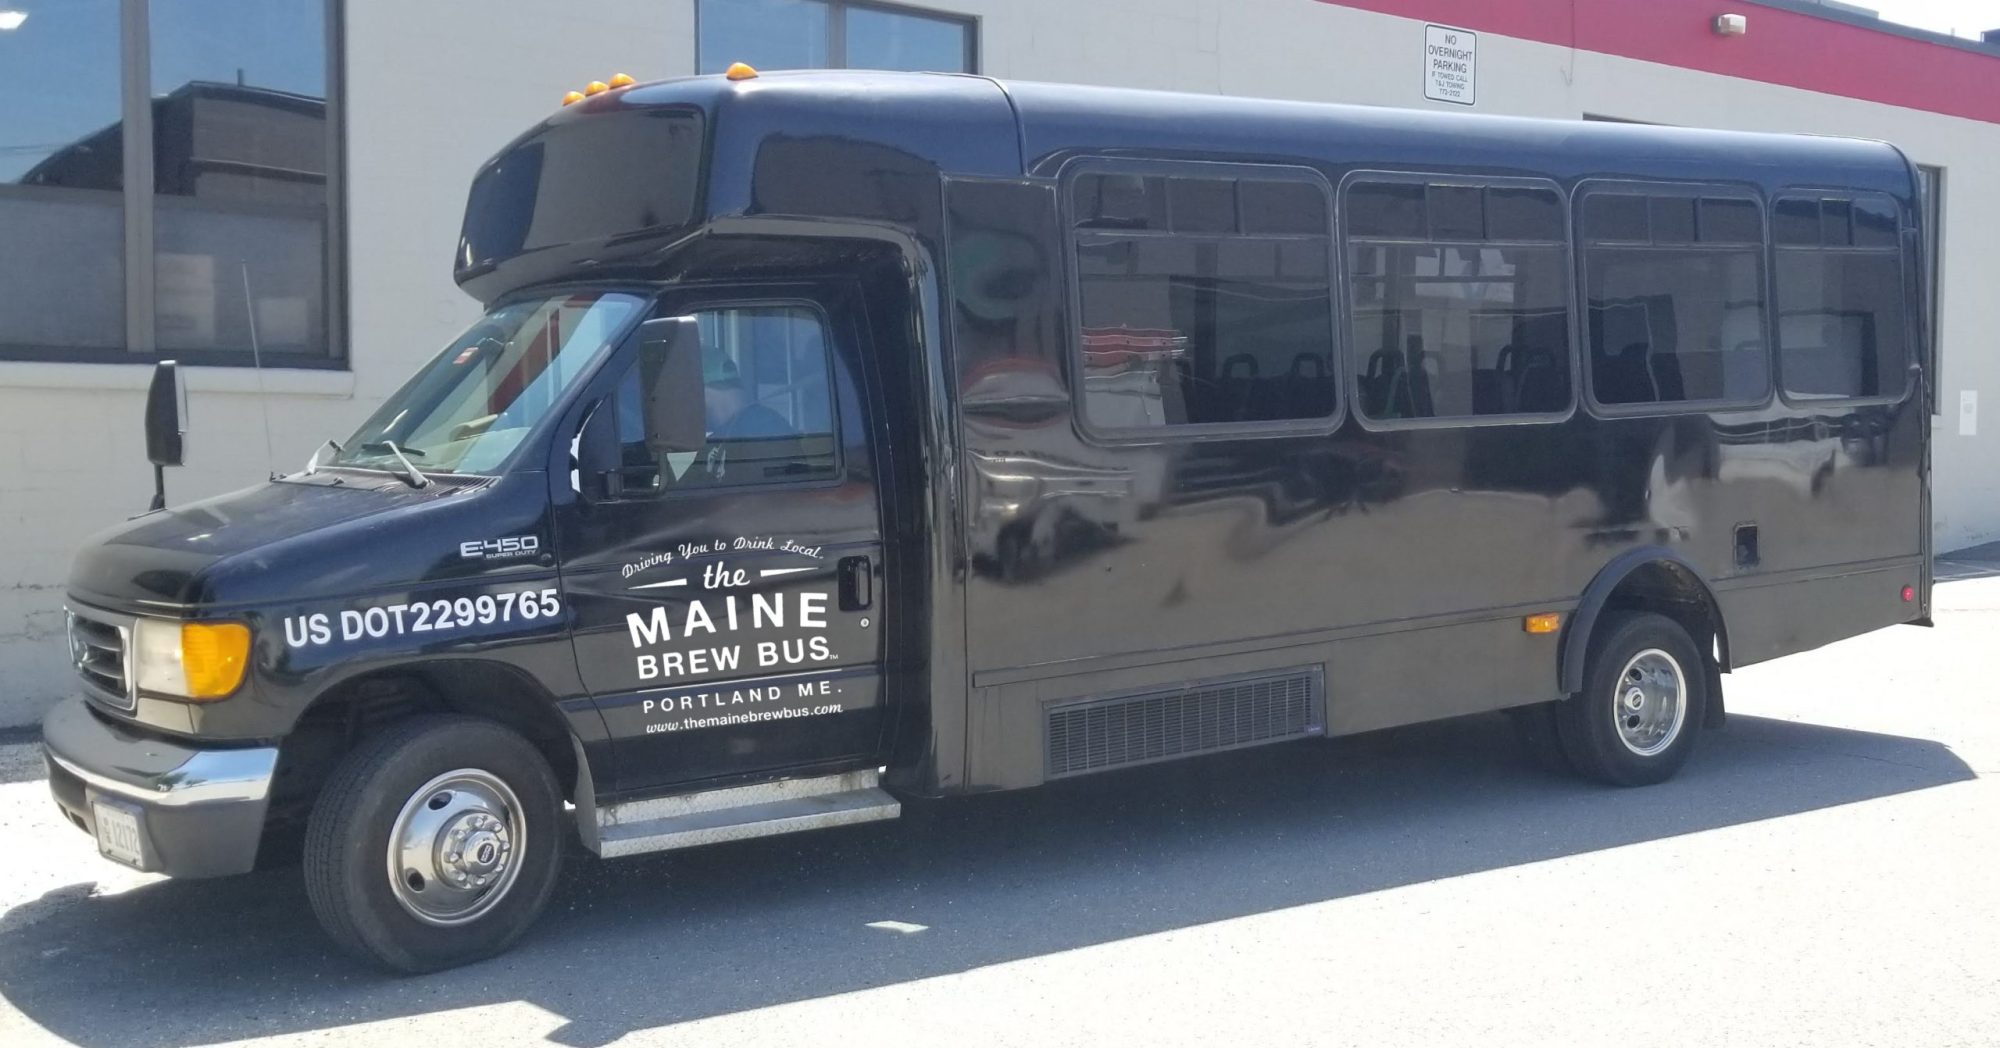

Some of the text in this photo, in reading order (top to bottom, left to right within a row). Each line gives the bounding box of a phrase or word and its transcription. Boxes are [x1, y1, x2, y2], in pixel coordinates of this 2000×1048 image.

[1428, 45, 1472, 61] OVERNIGHT
[1445, 34, 1457, 45] NO
[1433, 58, 1467, 73] PARKING
[1437, 72, 1454, 80] TOWED
[1455, 74, 1468, 83] CALL
[1446, 82, 1465, 90] TOWING
[486, 549, 536, 559] SUPER DUTY
[622, 551, 674, 579] Driving
[678, 542, 709, 560] You
[714, 539, 727, 551] to
[733, 536, 775, 550] Drink
[703, 561, 751, 589] the
[284, 588, 560, 648] US DOT2299765
[626, 592, 828, 648] MAINE
[637, 645, 740, 679] BREW
[757, 636, 830, 667] BUS
[643, 681, 842, 714] PORTLAND ME.
[646, 703, 844, 734] www.themainebrewbus.com
